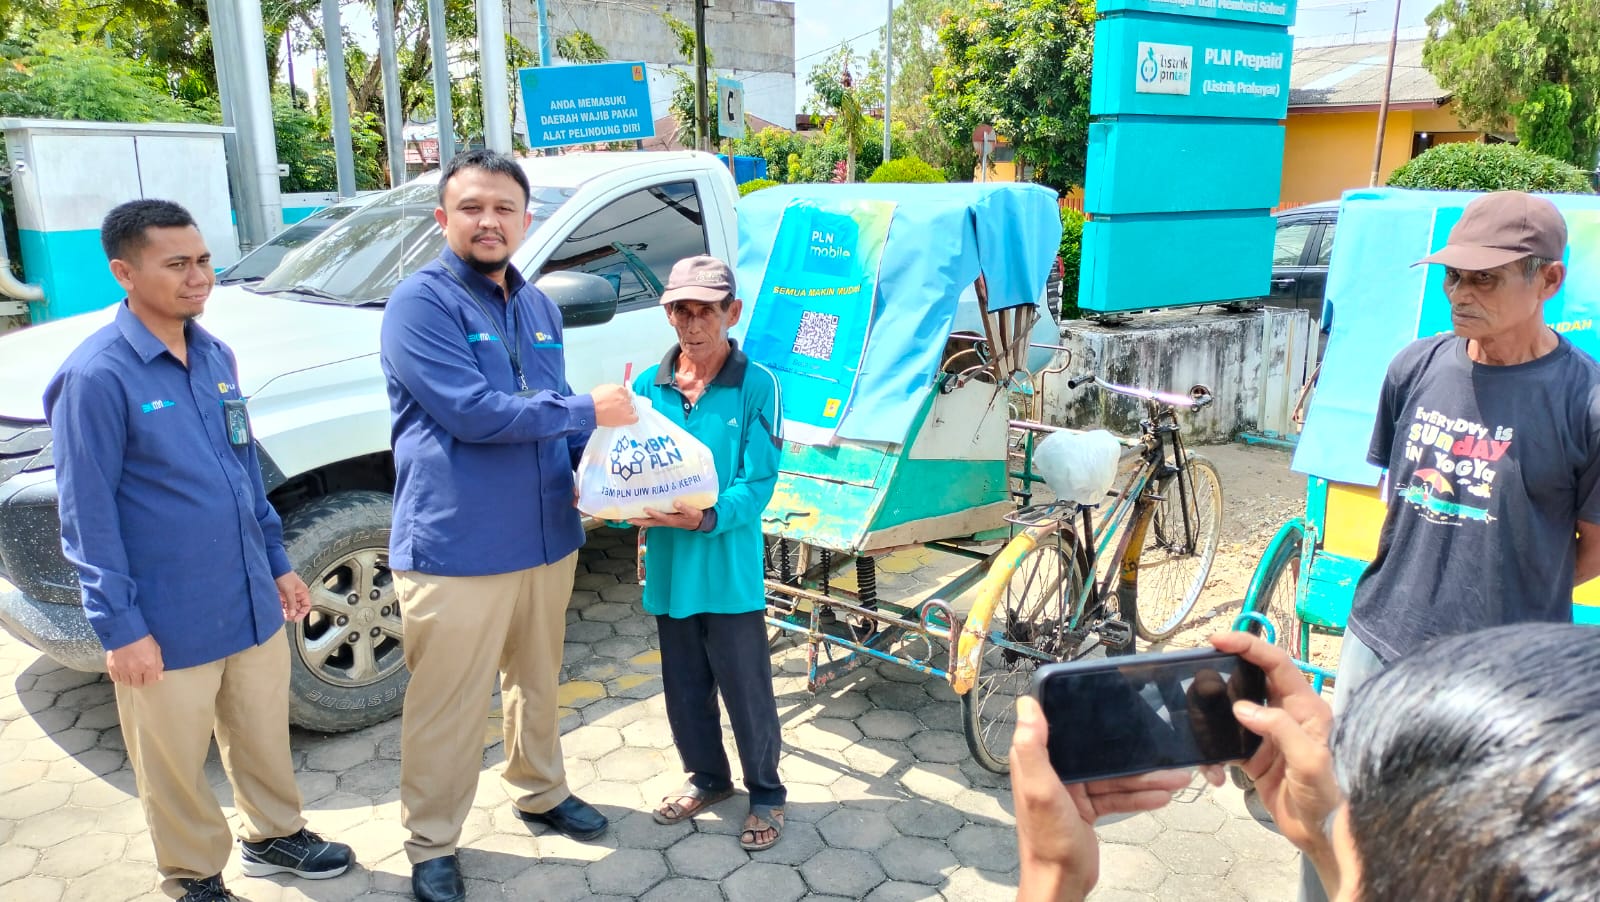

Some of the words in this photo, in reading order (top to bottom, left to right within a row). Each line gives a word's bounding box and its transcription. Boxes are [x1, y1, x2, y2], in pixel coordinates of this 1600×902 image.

[1259, 2, 1286, 15] Solusi
[1204, 48, 1231, 66] PLN
[1234, 50, 1283, 71] Prepaid
[1203, 80, 1235, 95] (Listrik
[1237, 82, 1280, 98] Prabayar)
[550, 100, 576, 111] ANDA
[577, 95, 627, 108] MEMASUKI
[541, 113, 579, 126] DAERAH
[580, 110, 610, 122] WAJIB
[611, 108, 638, 119] PAKAI
[543, 130, 566, 141] ALAT
[568, 125, 621, 139] PELINDUNG
[623, 122, 641, 133] DIRI
[811, 230, 834, 243] PLN
[810, 245, 851, 258] mobile
[773, 285, 806, 297] SEMUA
[808, 287, 834, 297] MAKIN
[644, 434, 676, 454] YBM
[649, 448, 683, 469] PLN
[616, 488, 631, 499] PLN
[634, 487, 649, 497] UIW
[652, 484, 669, 495] RIAU
[671, 482, 677, 490] &
[679, 474, 701, 489] KEPRI
